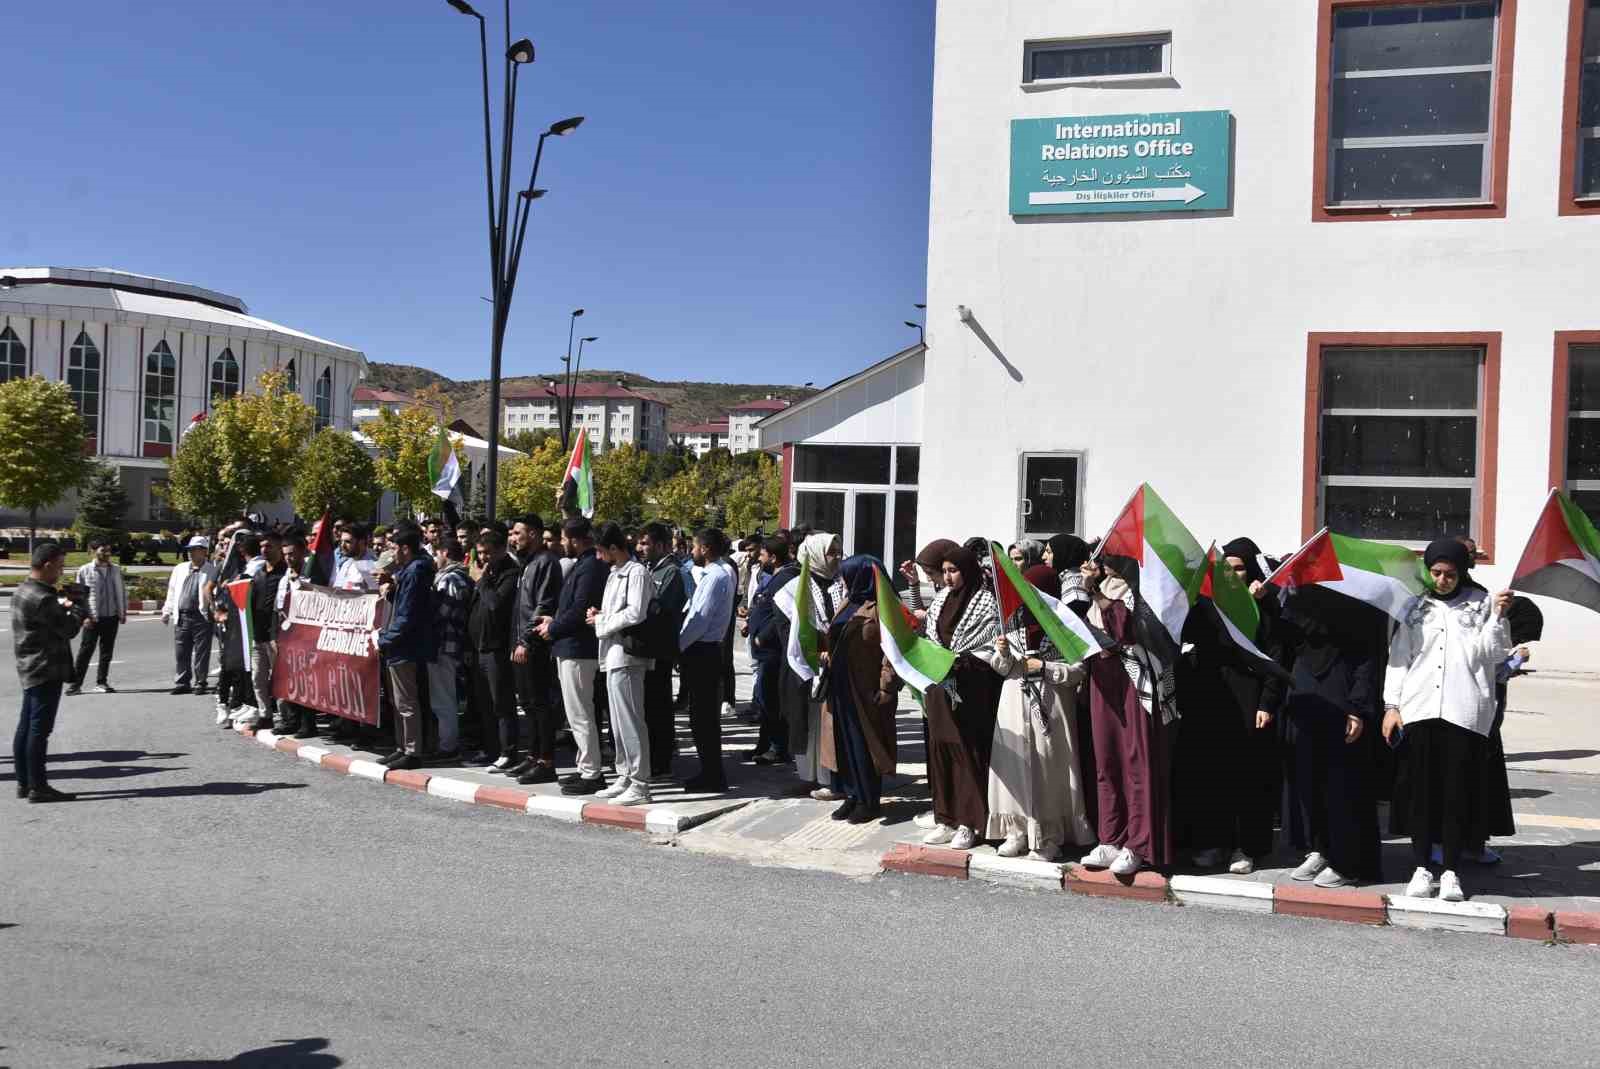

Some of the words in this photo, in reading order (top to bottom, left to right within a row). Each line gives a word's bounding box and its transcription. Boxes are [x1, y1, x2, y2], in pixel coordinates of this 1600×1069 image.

[1056, 118, 1182, 140] International
[1041, 143, 1129, 161] Relations
[1135, 139, 1194, 157] Office
[1042, 167, 1098, 188] الخارجية
[1102, 165, 1148, 185] الشؤون
[1154, 162, 1192, 182] مكتب
[1132, 190, 1155, 199] Ofisi
